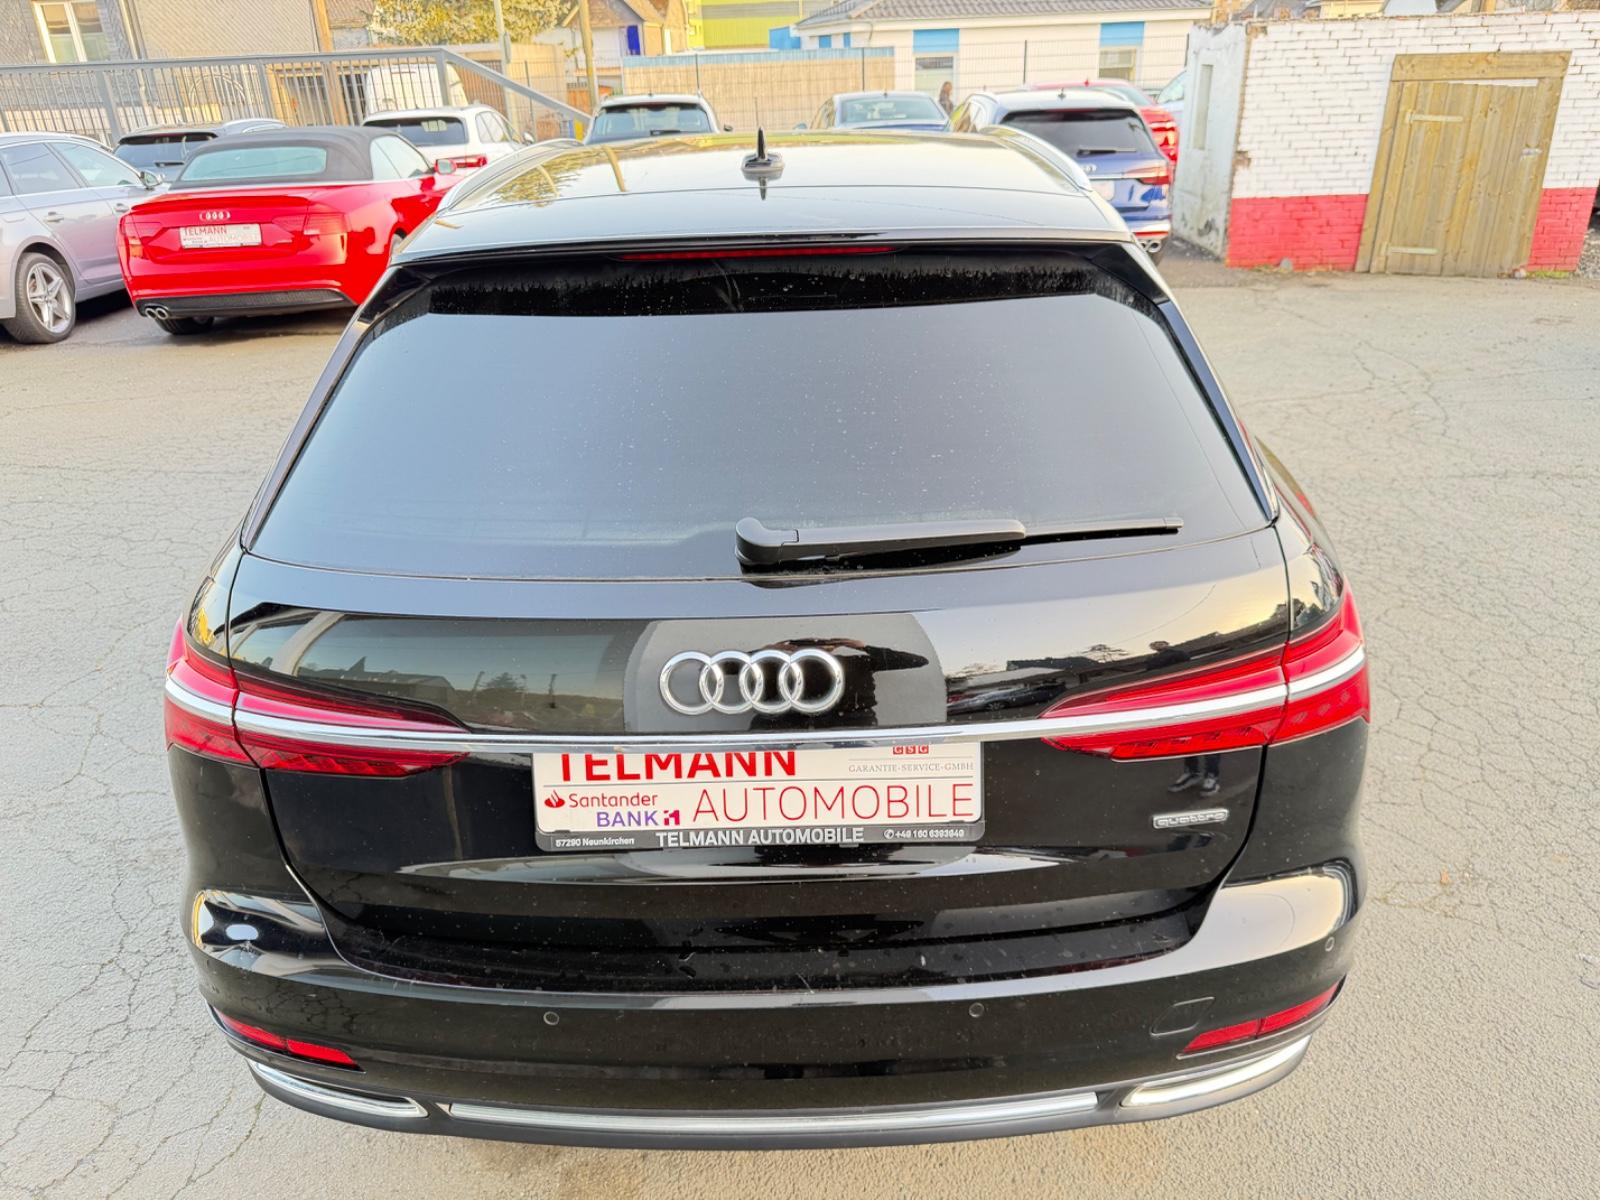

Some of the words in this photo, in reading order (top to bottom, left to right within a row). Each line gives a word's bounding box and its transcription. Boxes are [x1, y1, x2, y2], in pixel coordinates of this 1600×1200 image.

[893, 745, 929, 755] GSG
[561, 752, 795, 781] TELMANN
[568, 792, 658, 808] Santander
[693, 784, 973, 821] AUTOMOBILE
[597, 811, 659, 827] BANK
[582, 837, 635, 847] Neunkirchen
[656, 830, 745, 848] TELMANN
[748, 827, 864, 846] AUTOMOBILE
